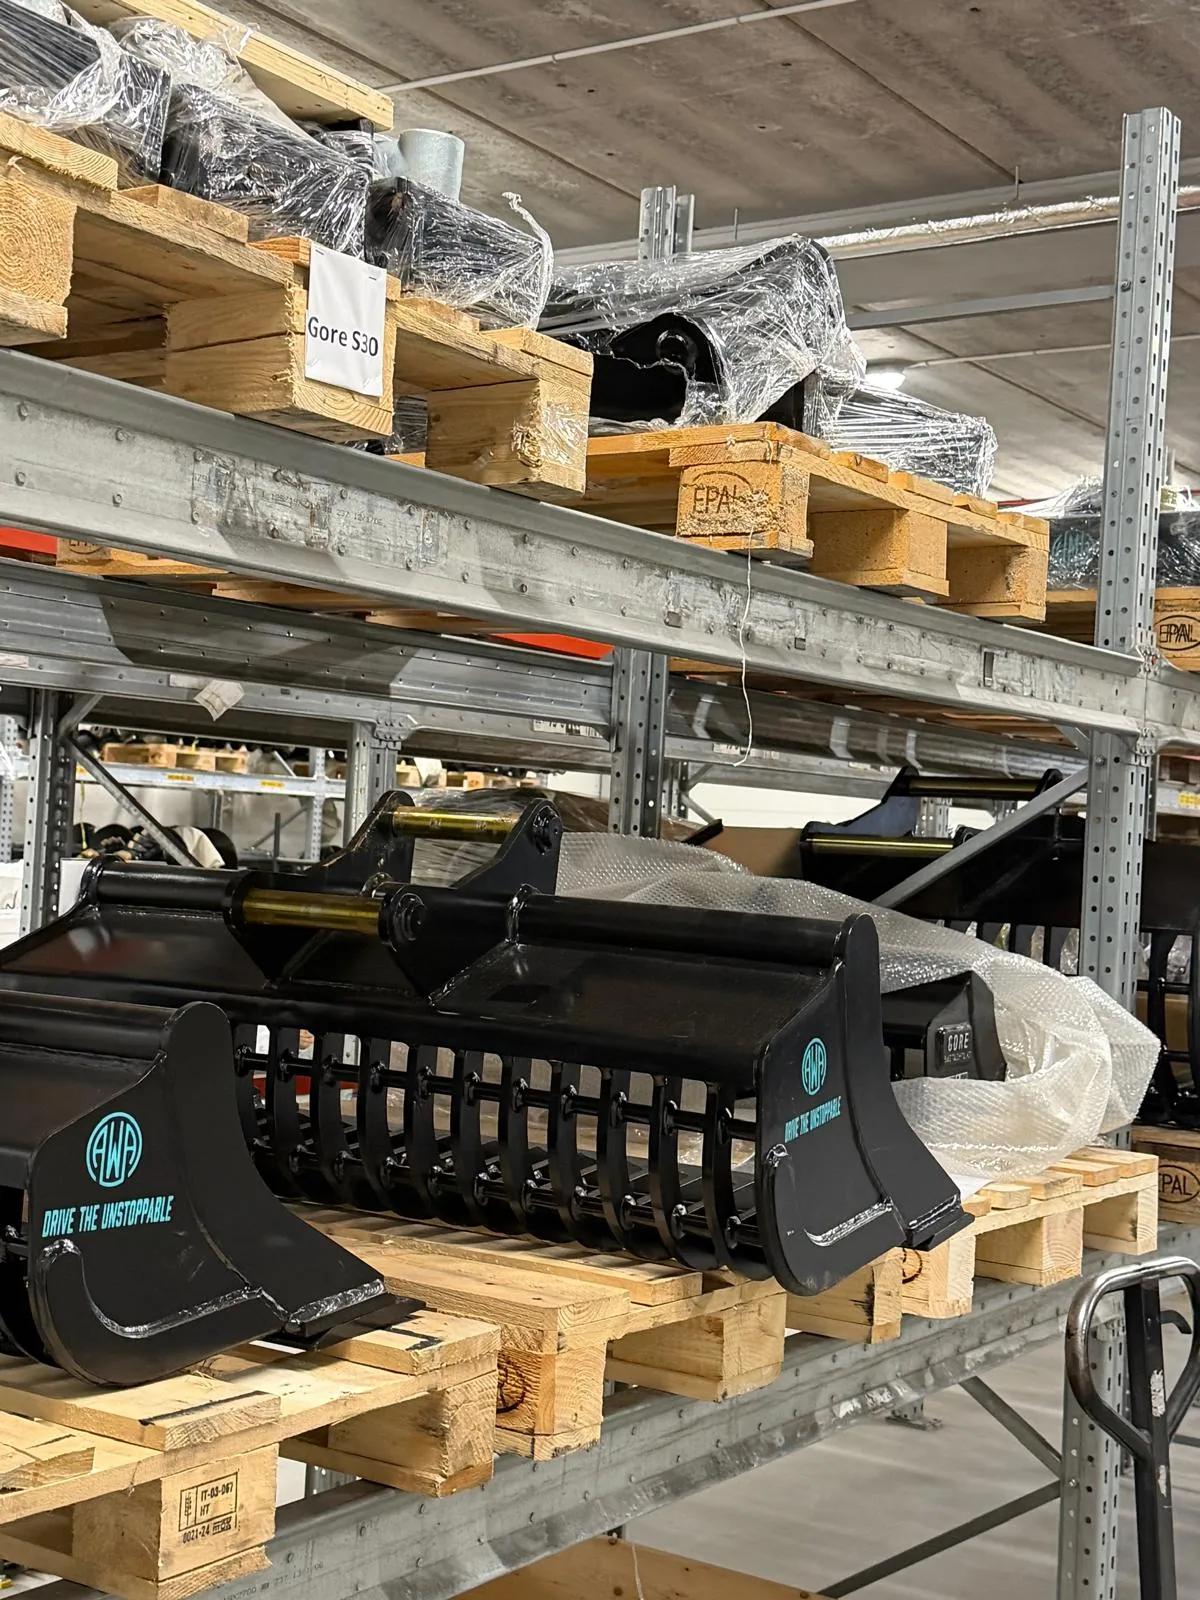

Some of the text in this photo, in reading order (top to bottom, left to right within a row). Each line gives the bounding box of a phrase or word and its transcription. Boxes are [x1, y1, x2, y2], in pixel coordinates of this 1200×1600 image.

[308, 316, 379, 357] Gore S30
[1159, 623, 1198, 643] EPAL
[947, 1032, 969, 1052] GORE
[801, 1038, 827, 1095] AWA
[86, 1112, 142, 1187] AWA
[1158, 1173, 1193, 1195] PAL
[42, 1195, 174, 1237] DRIVE THE UNSTOPPABLE
[200, 1503, 210, 1517] HT
